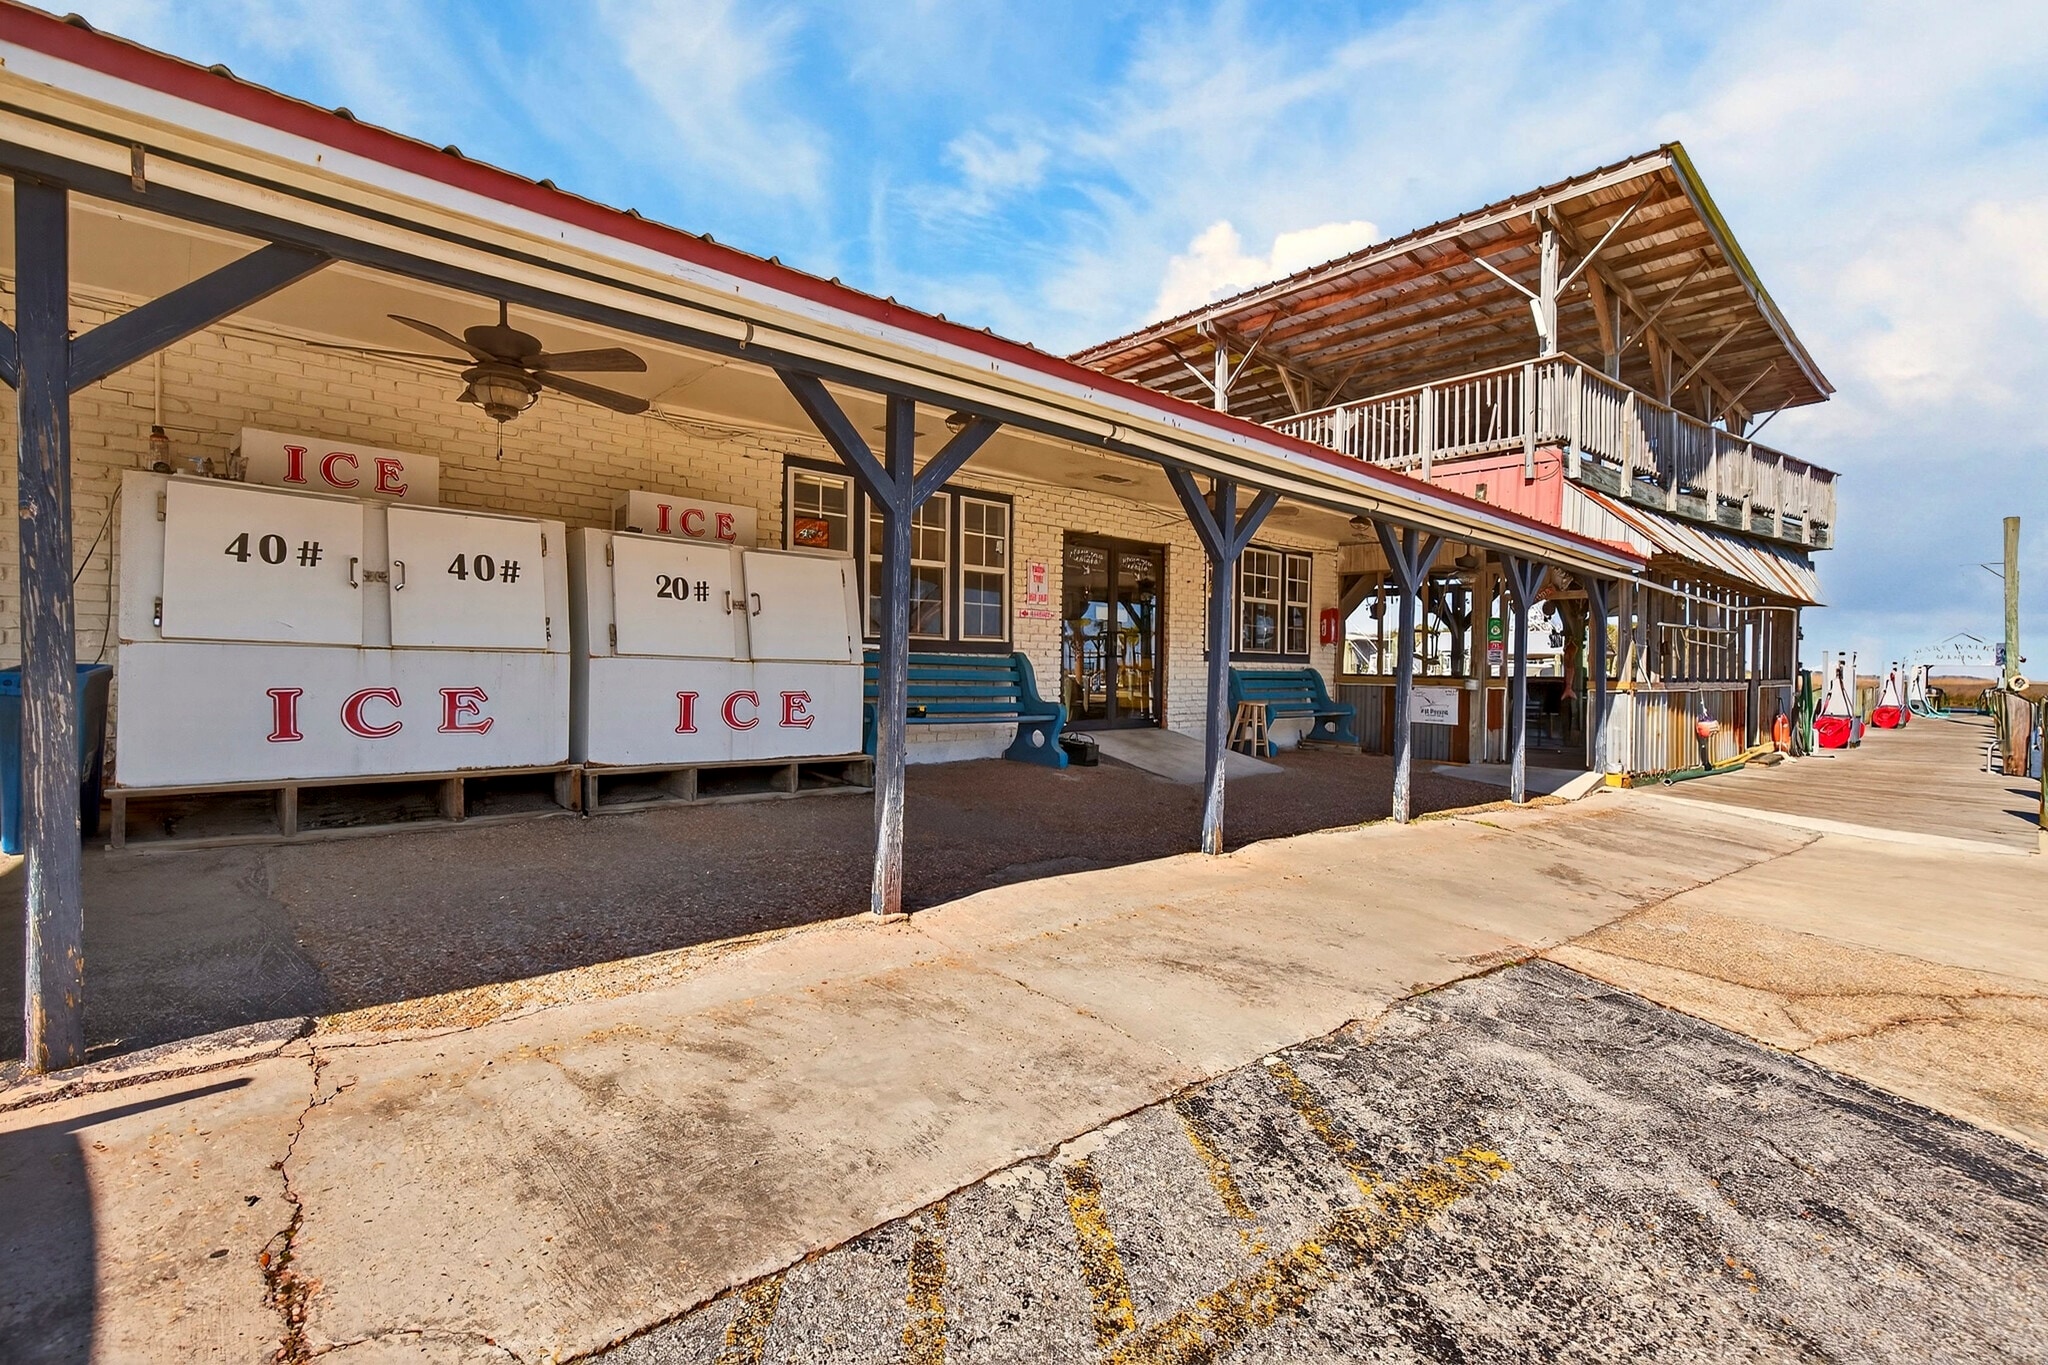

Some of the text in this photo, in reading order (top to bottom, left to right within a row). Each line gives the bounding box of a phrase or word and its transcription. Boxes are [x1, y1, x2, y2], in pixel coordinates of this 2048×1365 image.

[283, 444, 409, 498] ICE
[656, 503, 737, 545] ICE
[224, 531, 324, 568] 40#
[447, 552, 521, 584] 40#
[655, 574, 710, 602] 20#
[265, 685, 495, 744] ICE
[674, 689, 816, 735] ICE
